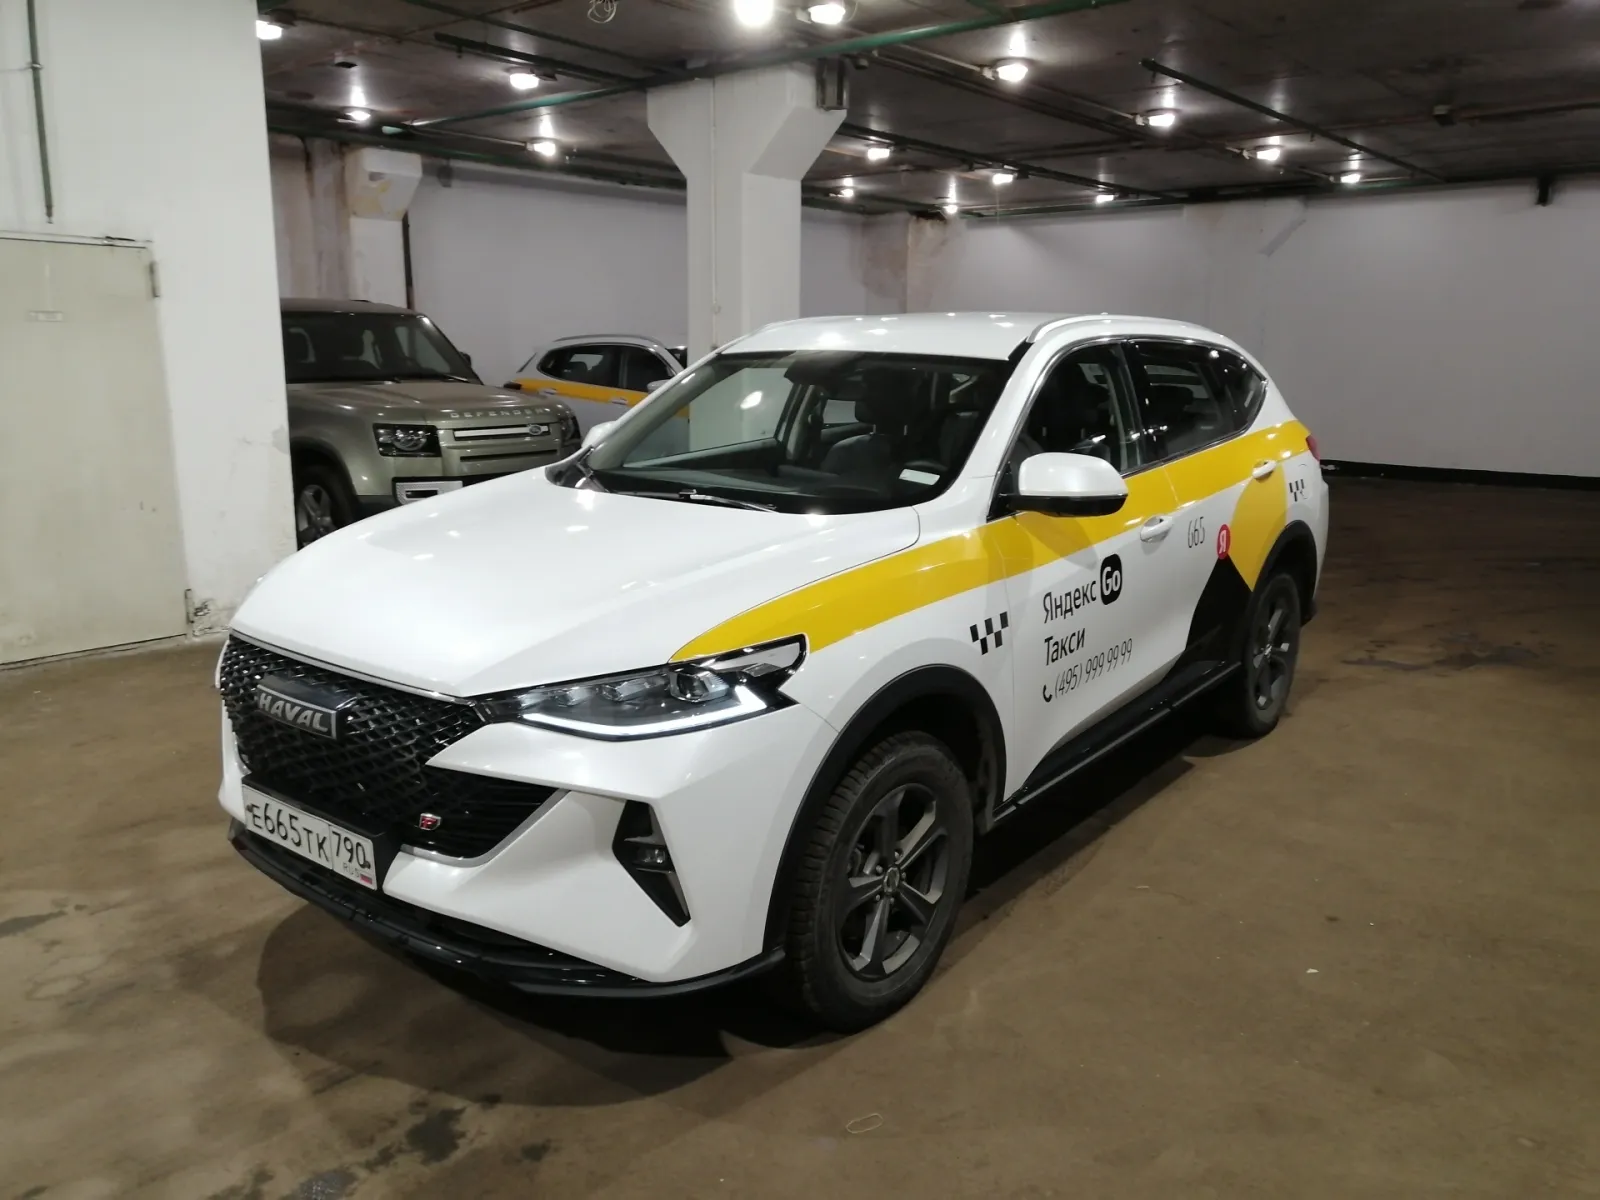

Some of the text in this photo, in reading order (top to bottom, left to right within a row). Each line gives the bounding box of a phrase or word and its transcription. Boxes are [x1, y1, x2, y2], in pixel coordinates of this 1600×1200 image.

[1187, 516, 1206, 549] 665
[1218, 529, 1227, 554] Я
[1043, 566, 1121, 624] Яндекс Go
[1044, 627, 1085, 666] Такси
[1054, 662, 1083, 699] (495)
[1085, 652, 1105, 683] 999
[257, 691, 329, 733] HAVAL
